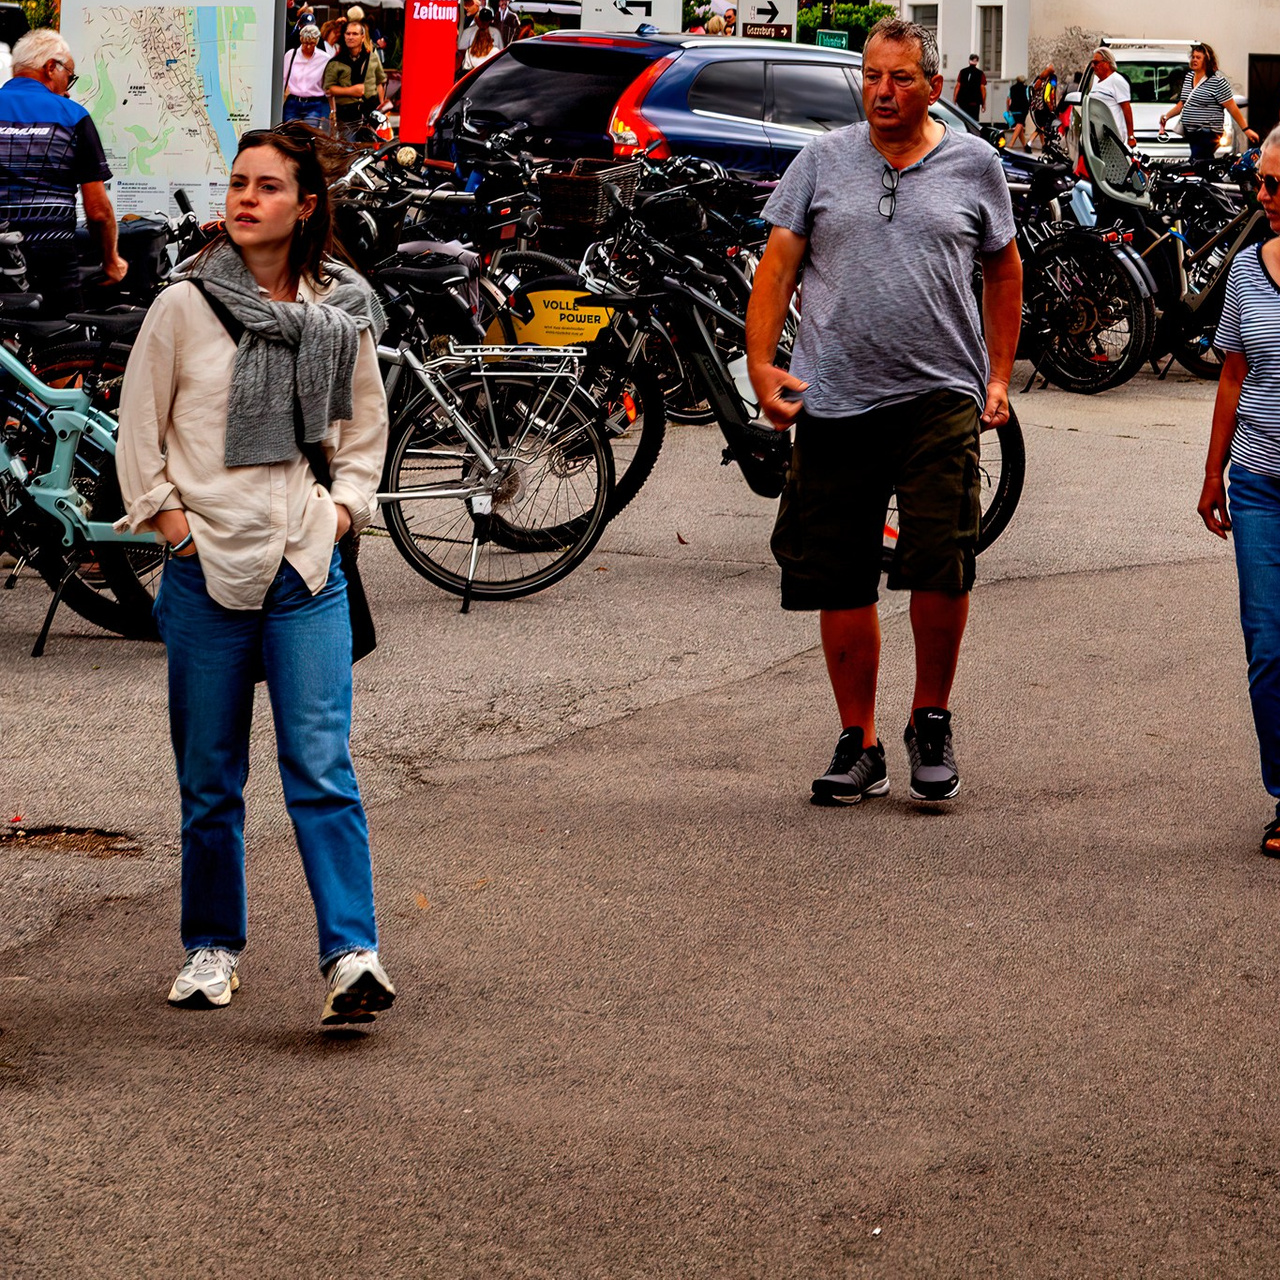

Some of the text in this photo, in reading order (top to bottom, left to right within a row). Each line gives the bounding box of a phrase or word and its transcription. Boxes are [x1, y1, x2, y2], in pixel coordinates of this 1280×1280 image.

[413, 2, 458, 22] Zeitung
[542, 299, 579, 312] VOLLE
[559, 313, 601, 325] POWER
